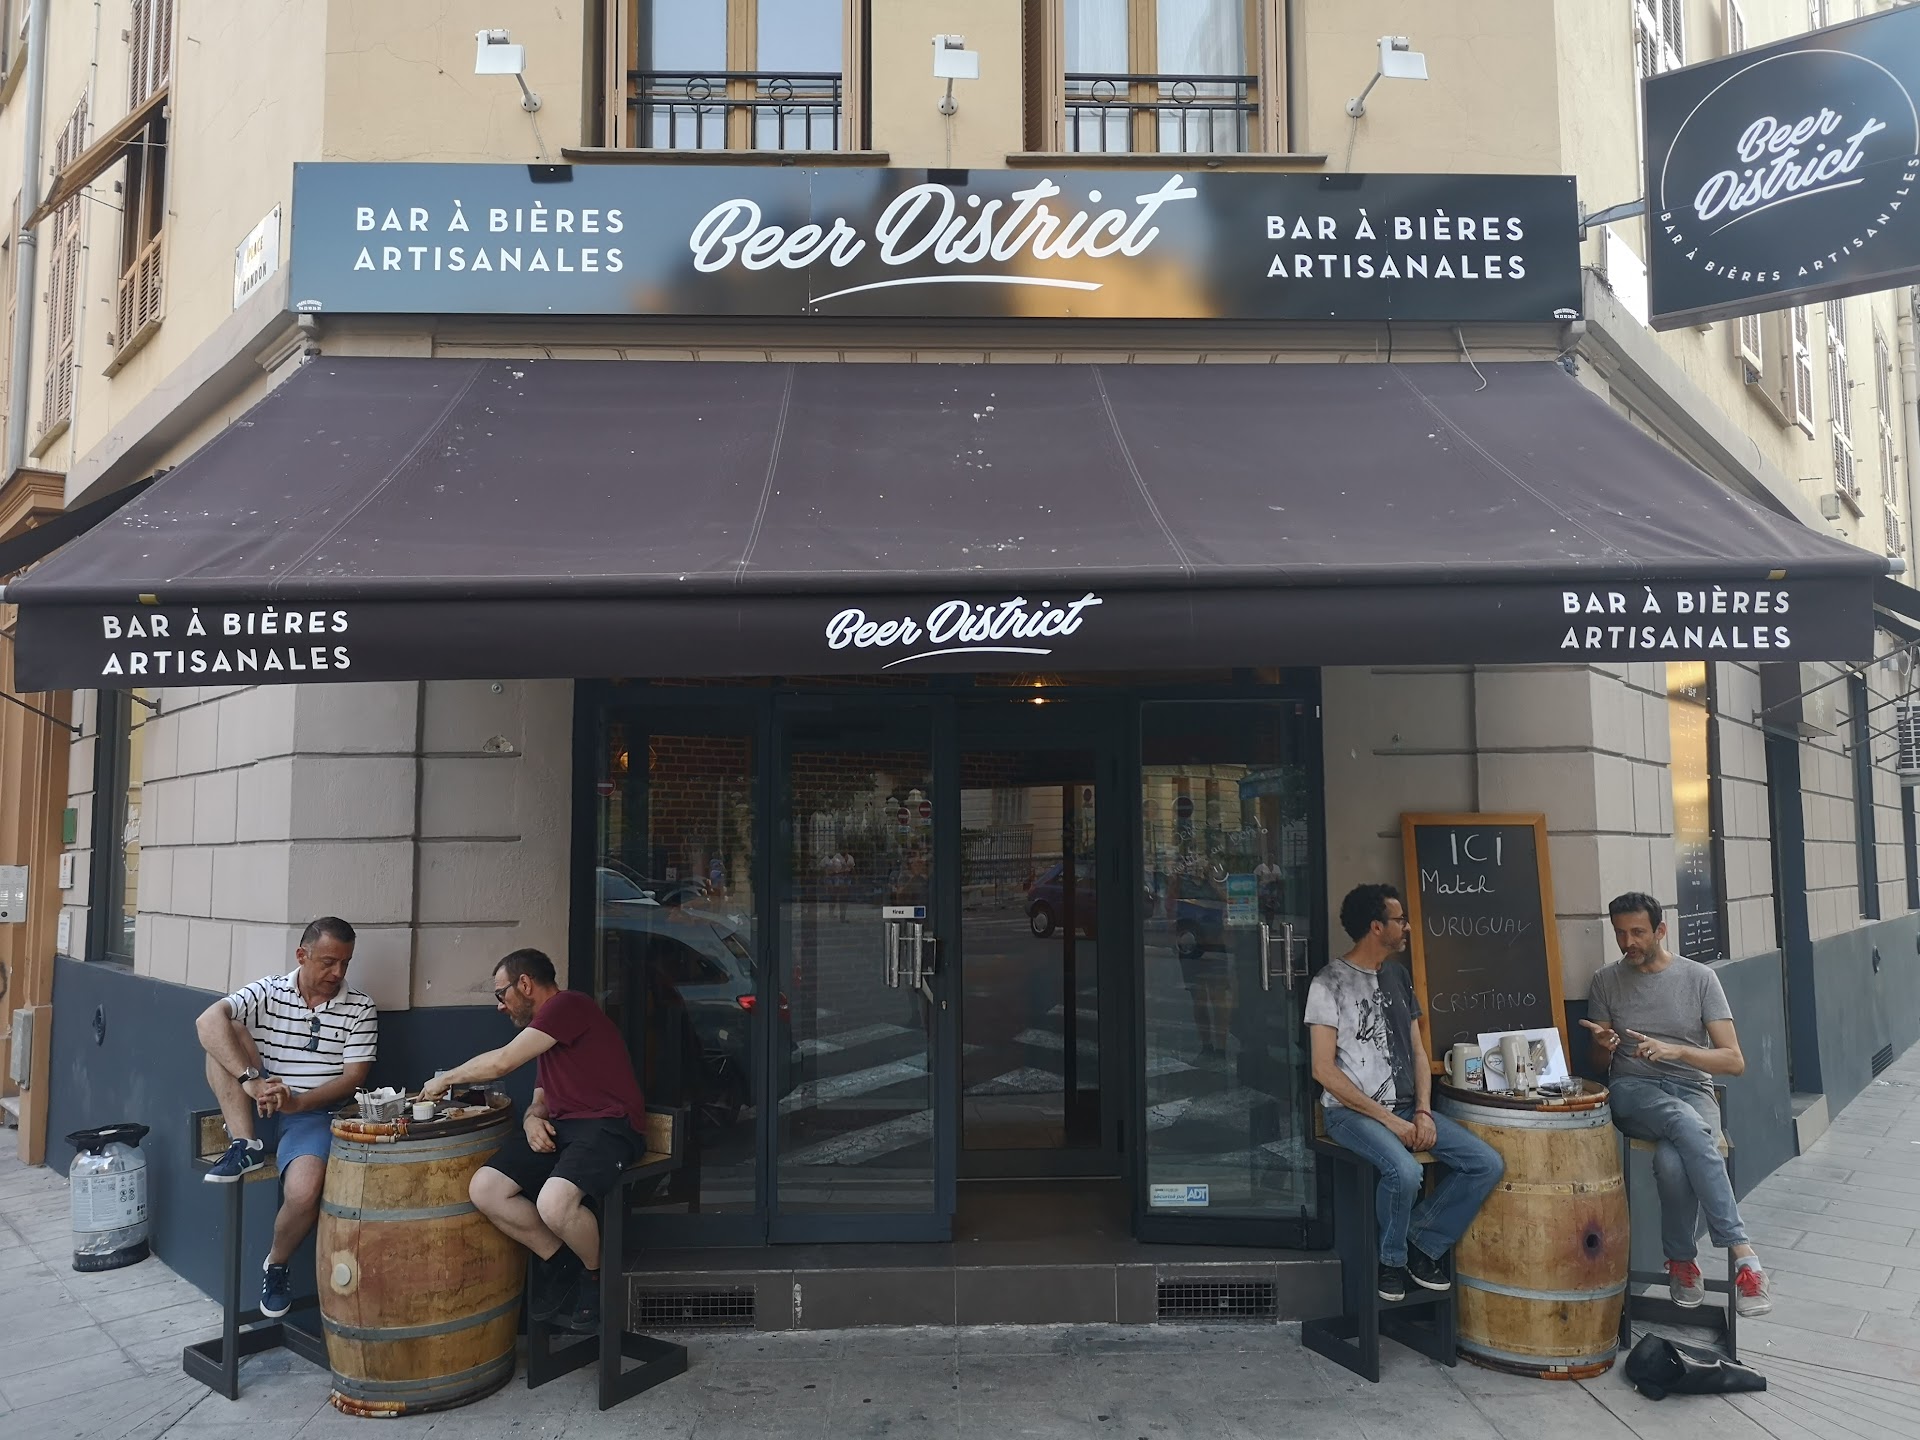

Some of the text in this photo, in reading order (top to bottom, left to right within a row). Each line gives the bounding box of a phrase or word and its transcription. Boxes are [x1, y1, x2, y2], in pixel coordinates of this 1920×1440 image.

[1737, 107, 1842, 163] Beer
[1694, 117, 1886, 221] District
[357, 199, 624, 234] BAR À BIÈRES
[689, 173, 1198, 273] Beer District
[1267, 208, 1524, 241] BAR À BIÈRES
[1660, 158, 1920, 282] BAR À BIÈRES ARTISANALES
[353, 246, 623, 273] ARTISANALES
[1266, 254, 1526, 280] ARTISANALES
[242, 261, 267, 295] RANDON
[1562, 584, 1789, 614] BAR À BIÈRES
[102, 605, 348, 639] BAR À BIÈRES
[825, 592, 1103, 650] Beer District
[1560, 626, 1791, 649] ARTISANALES
[101, 646, 351, 675] ARTISANALES
[1421, 868, 1495, 894] Match
[1428, 916, 1531, 948] URUGUAY
[1187, 1188, 1206, 1200] ADT
